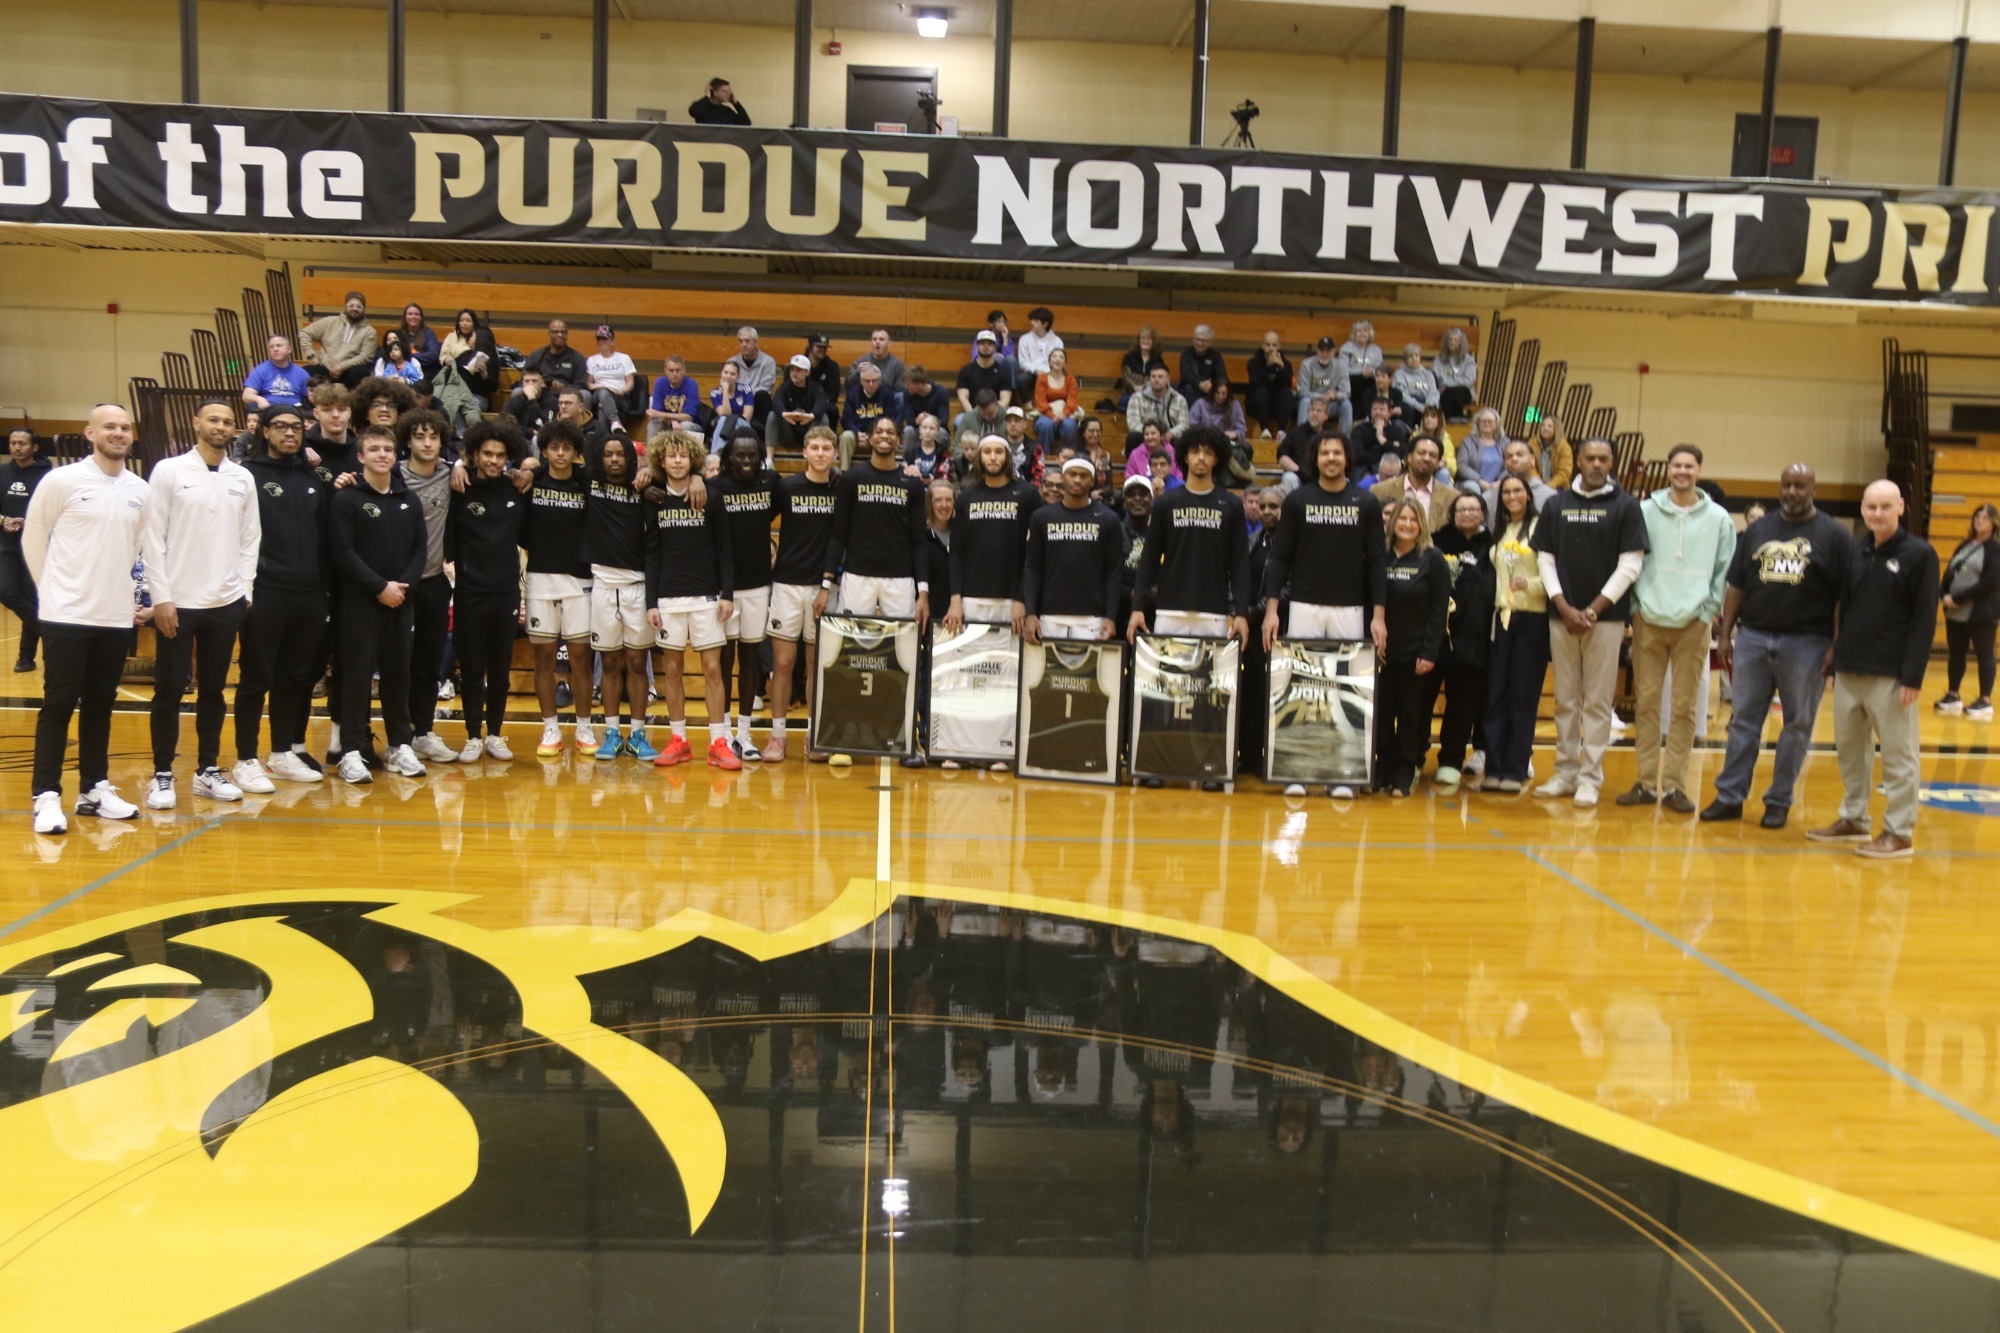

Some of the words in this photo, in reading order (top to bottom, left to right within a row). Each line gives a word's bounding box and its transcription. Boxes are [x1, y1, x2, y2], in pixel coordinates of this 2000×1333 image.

[0, 117, 112, 209] of
[160, 120, 366, 222] the
[408, 131, 929, 241] PURDUE
[971, 155, 1764, 283] NORTHWEST
[533, 487, 585, 502] PURDUE
[723, 491, 772, 505] PURDUE
[858, 484, 908, 499] PURDUE
[532, 497, 584, 509] NORTHWEST
[791, 495, 836, 506] PURDU
[858, 494, 907, 505] NORTHWEST
[969, 502, 1018, 513] PURDUE
[1172, 507, 1222, 520] PURDUE
[1305, 504, 1359, 517] PURDUE
[658, 508, 705, 521] PURDUE
[969, 511, 1018, 520] NORTHWEST
[1305, 514, 1359, 526] NORTHWEST
[1047, 522, 1100, 534] PURDUE
[1173, 518, 1222, 529] NORTHWEST
[1047, 532, 1099, 542] NORTHWEST
[1764, 558, 1805, 575] PNW
[850, 656, 887, 668] PURDUE
[860, 672, 873, 696] 3
[1052, 675, 1089, 685] PURDUE
[973, 677, 987, 697] 5
[1065, 693, 1073, 718] 1
[1174, 695, 1194, 720] 12
